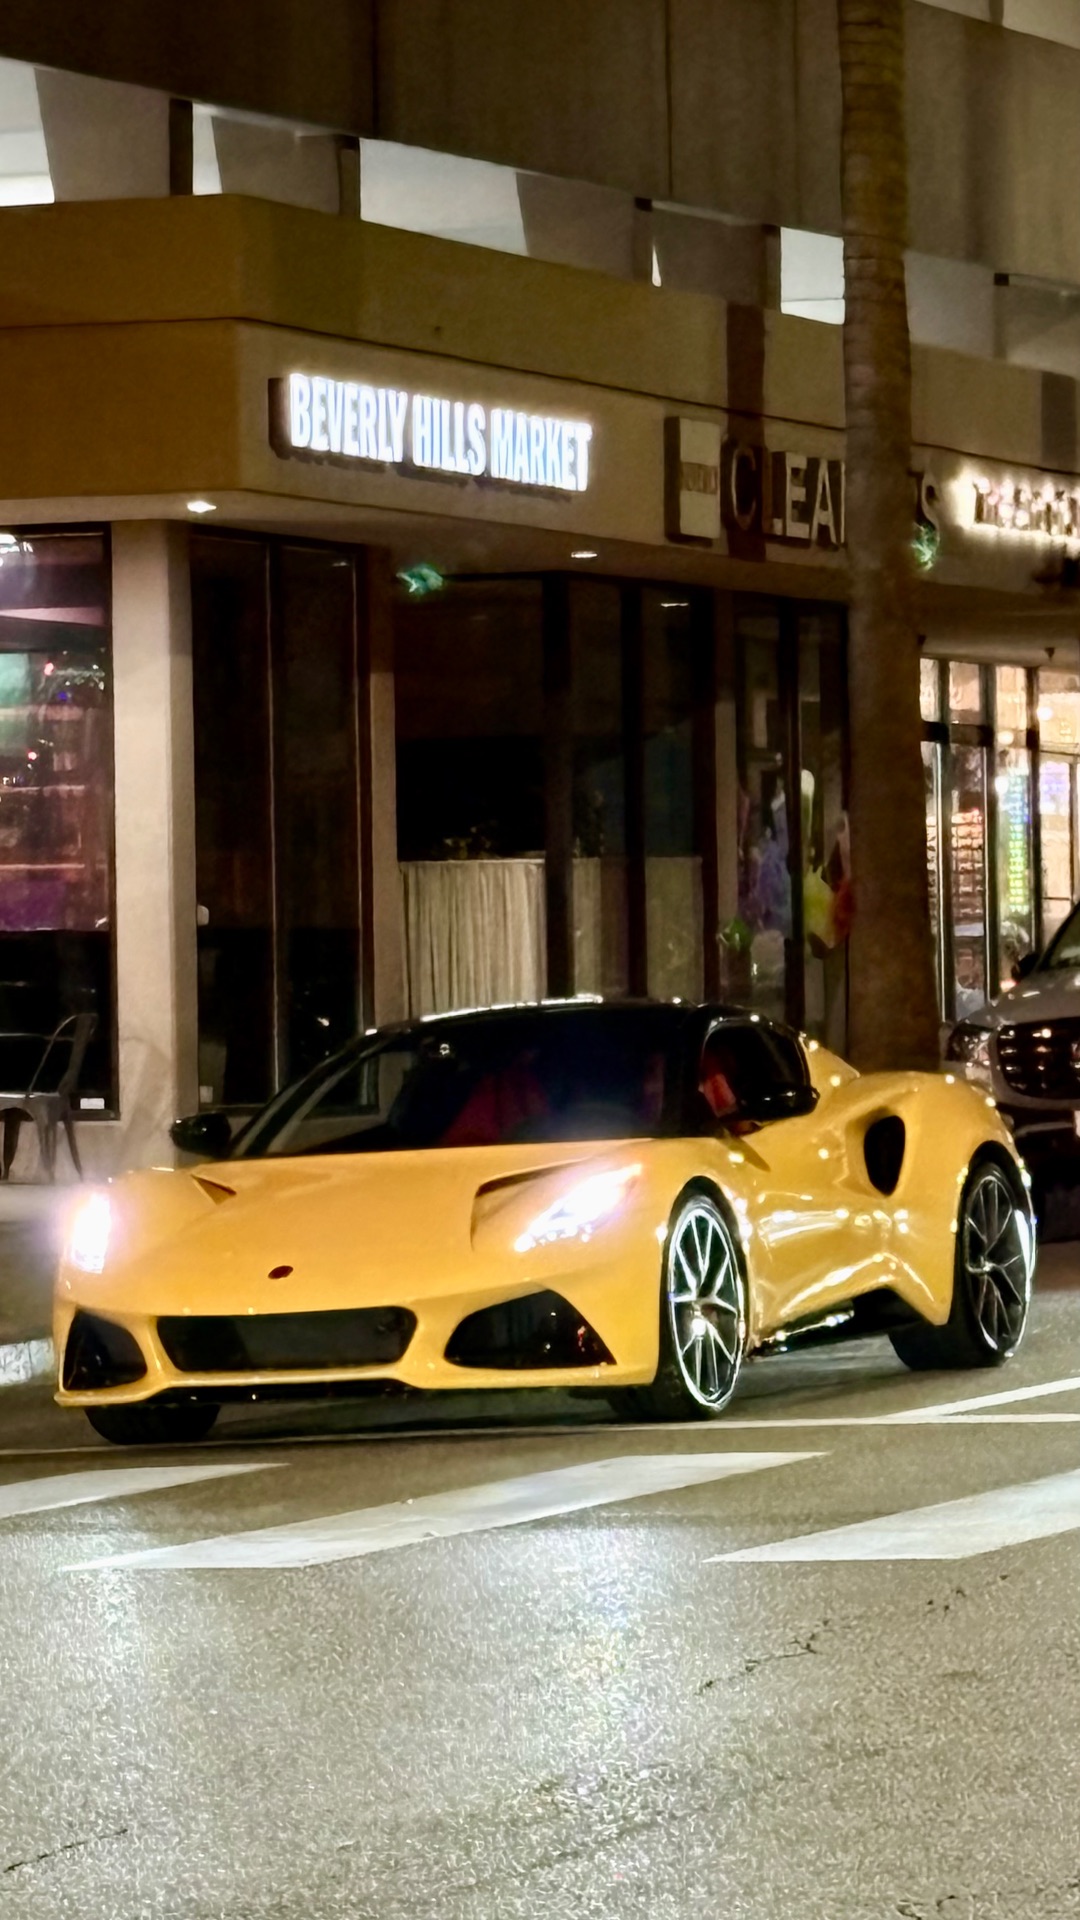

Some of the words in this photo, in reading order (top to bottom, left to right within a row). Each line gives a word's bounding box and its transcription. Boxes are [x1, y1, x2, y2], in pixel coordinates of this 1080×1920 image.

[290, 373, 407, 463] BEVERLY
[413, 394, 486, 476] HILLS
[490, 408, 592, 492] MARKET
[731, 448, 940, 553] CLEAS
